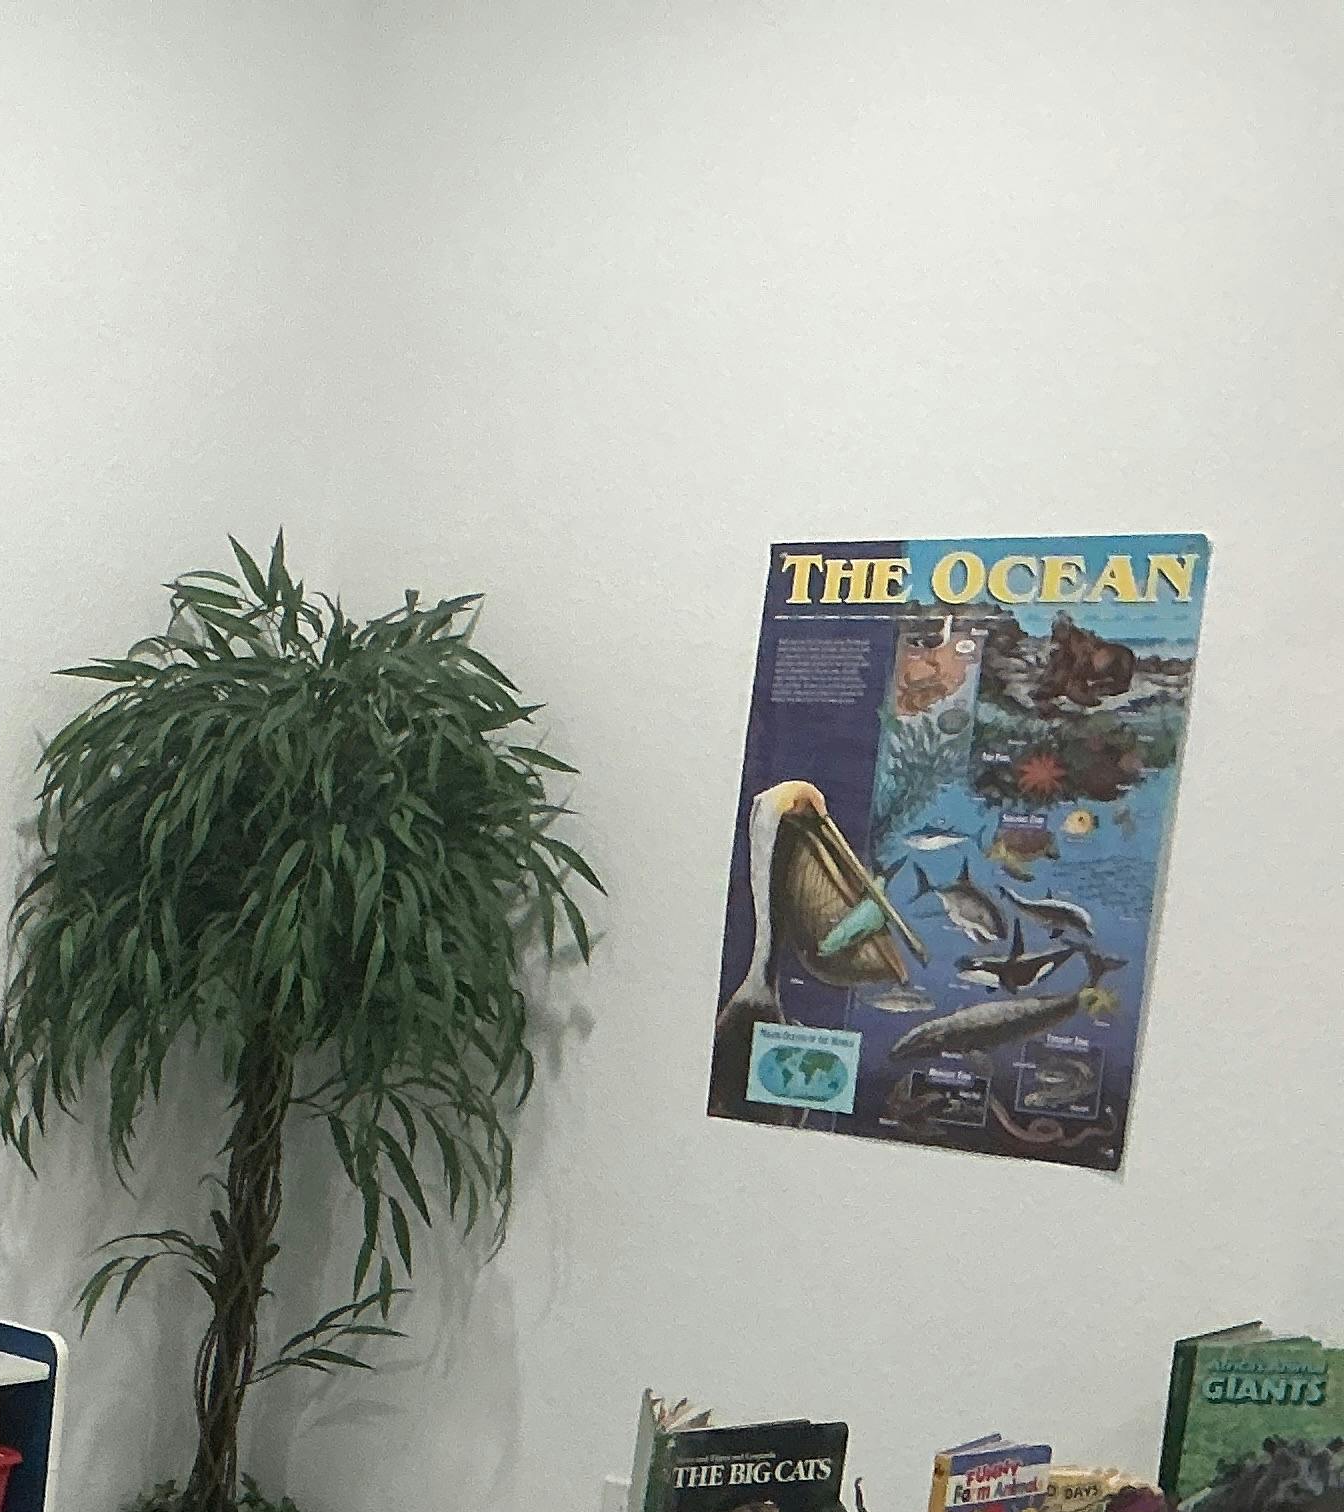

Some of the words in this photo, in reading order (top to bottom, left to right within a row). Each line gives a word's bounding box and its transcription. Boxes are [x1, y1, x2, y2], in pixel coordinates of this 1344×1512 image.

[781, 554, 912, 604] THE
[930, 551, 1201, 604] OCEAN
[1202, 1374, 1328, 1406] GIANTS
[673, 1464, 725, 1489] THE
[728, 1461, 772, 1485] BIG
[774, 1457, 832, 1482] CATS
